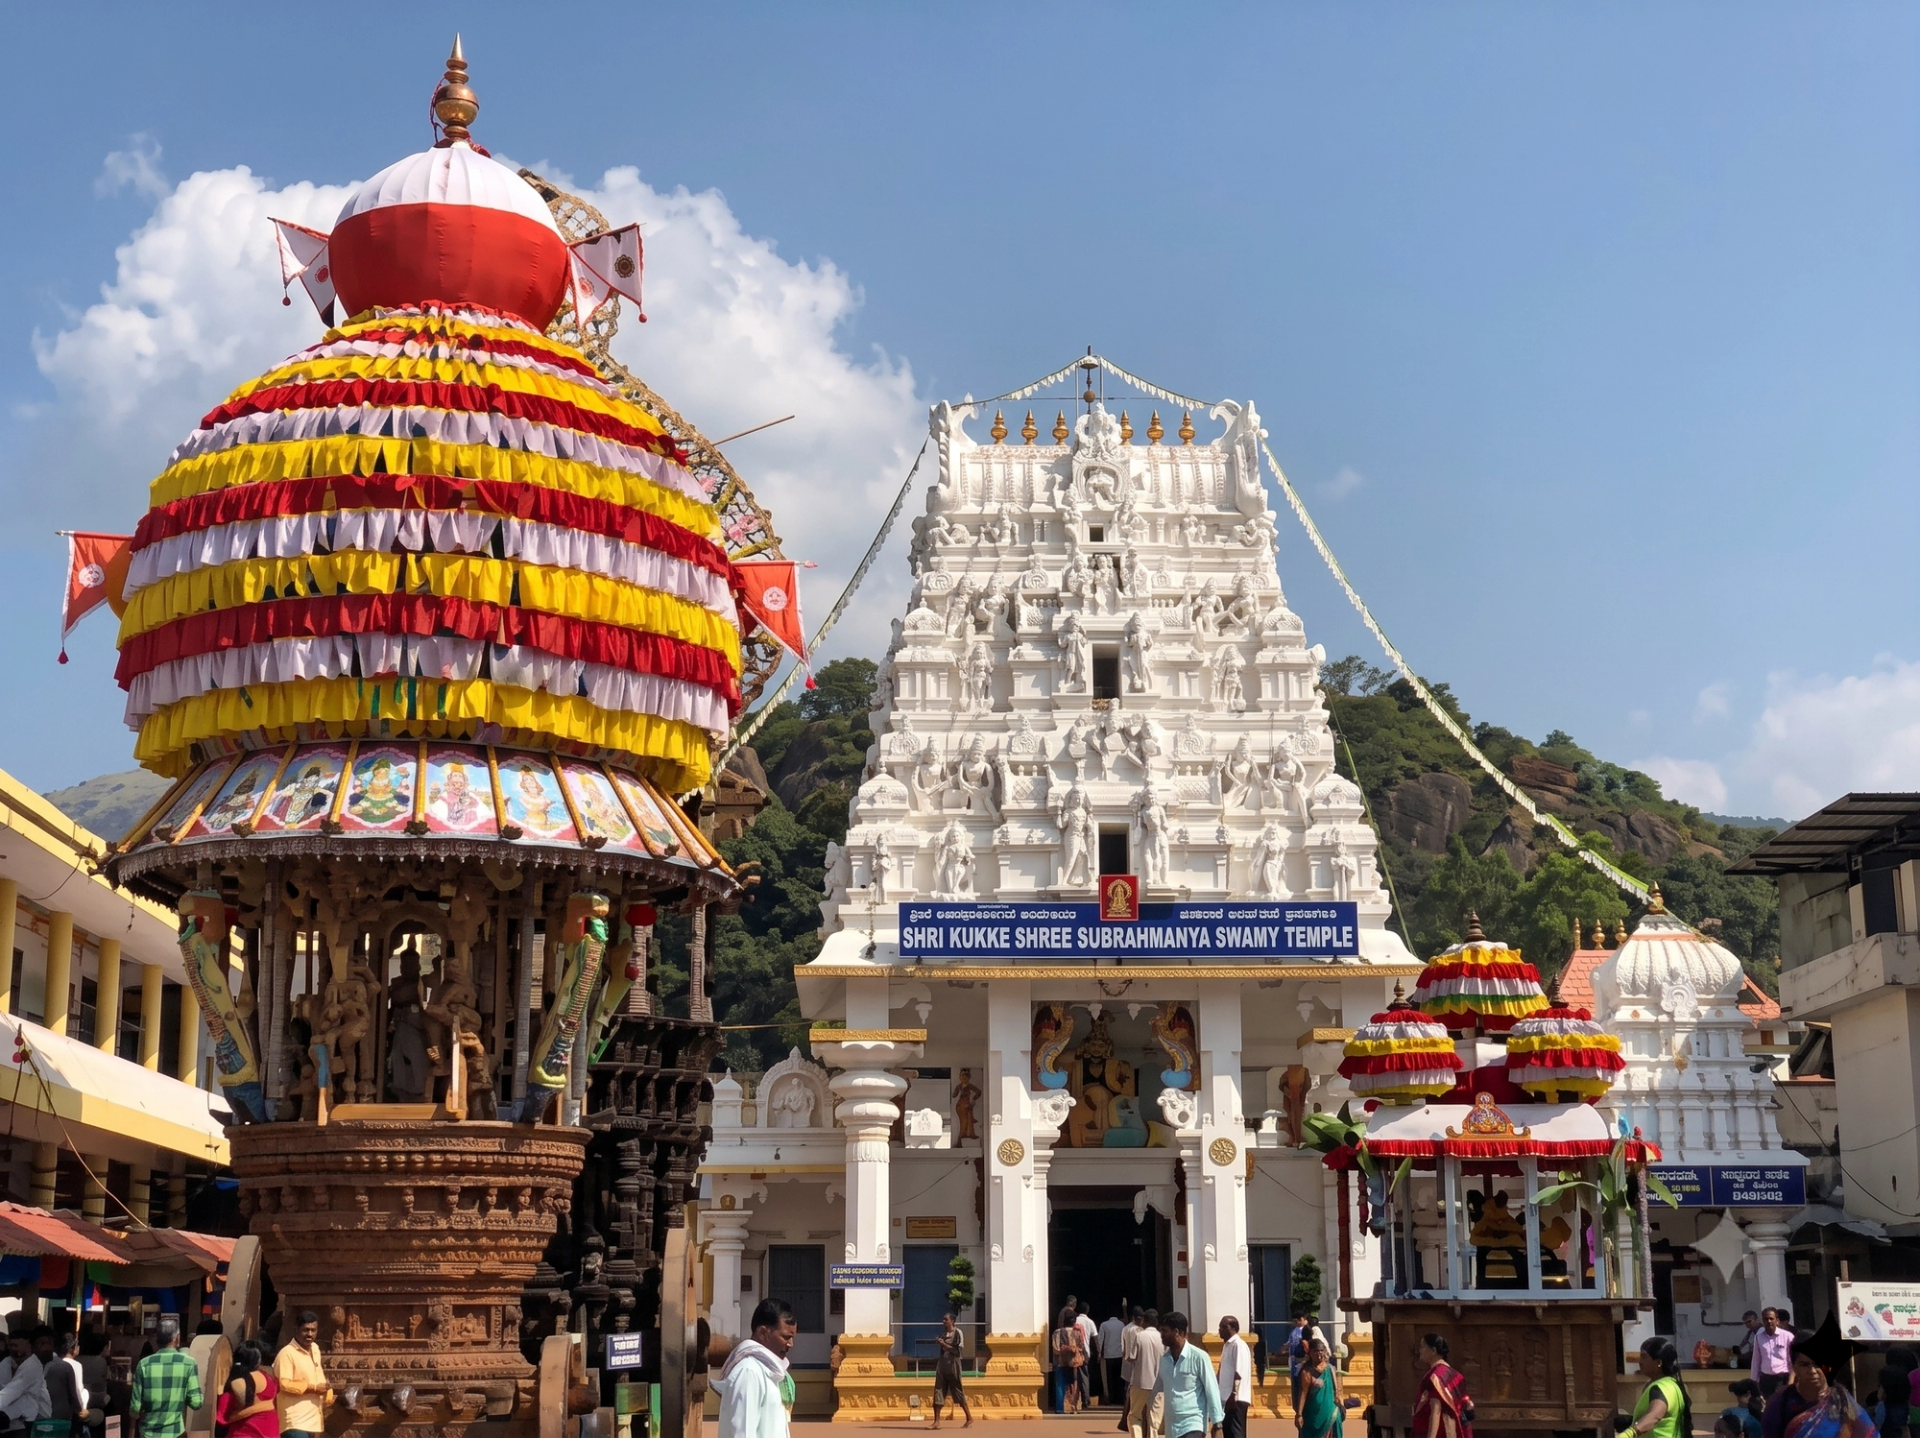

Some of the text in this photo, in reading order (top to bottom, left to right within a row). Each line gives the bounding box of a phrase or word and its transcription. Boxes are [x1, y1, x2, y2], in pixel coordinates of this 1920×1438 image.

[902, 926, 1353, 949] SHRI KUKKE SHREE SUBRAHMANYA SWAMY TEMPLE
